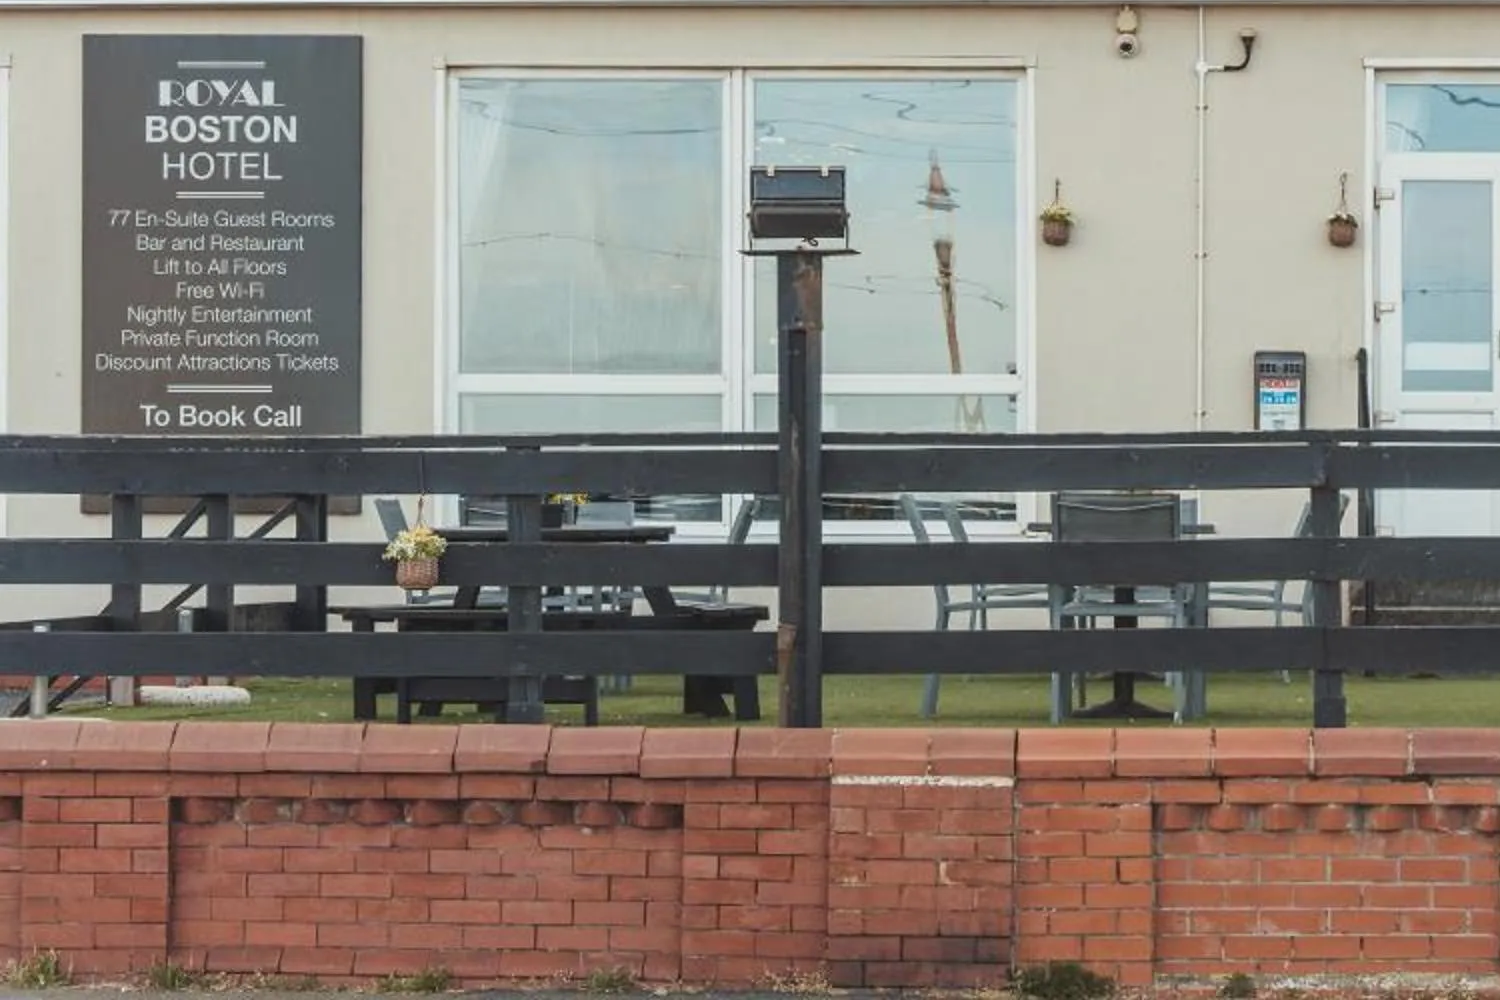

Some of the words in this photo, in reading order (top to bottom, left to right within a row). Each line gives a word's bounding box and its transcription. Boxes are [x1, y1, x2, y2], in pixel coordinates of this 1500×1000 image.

[158, 78, 285, 107] ROYAL
[145, 115, 297, 144] BOSTON
[162, 151, 283, 181] HOTEL
[108, 209, 131, 227] 77
[135, 209, 209, 228] En-Suite
[213, 209, 266, 228] Guest
[271, 210, 335, 228] Rooms
[135, 233, 167, 251] Bar
[171, 234, 206, 252] and
[209, 233, 305, 252] Restaurant
[153, 258, 180, 275] Lift
[184, 259, 204, 275] to
[207, 258, 229, 275] All
[233, 257, 287, 276] Floors
[175, 281, 215, 299] Free
[218, 281, 265, 299] Wi-Fi
[127, 305, 187, 327] Nightly
[191, 305, 312, 324] Entertainment
[121, 329, 181, 347] Private
[185, 329, 261, 348] Function
[265, 329, 319, 347] Room
[95, 353, 172, 371] Discount
[177, 353, 271, 372] Attractions
[275, 353, 340, 372] Tickets
[139, 404, 171, 427] To
[179, 404, 246, 427] Book
[253, 404, 302, 427] Call
